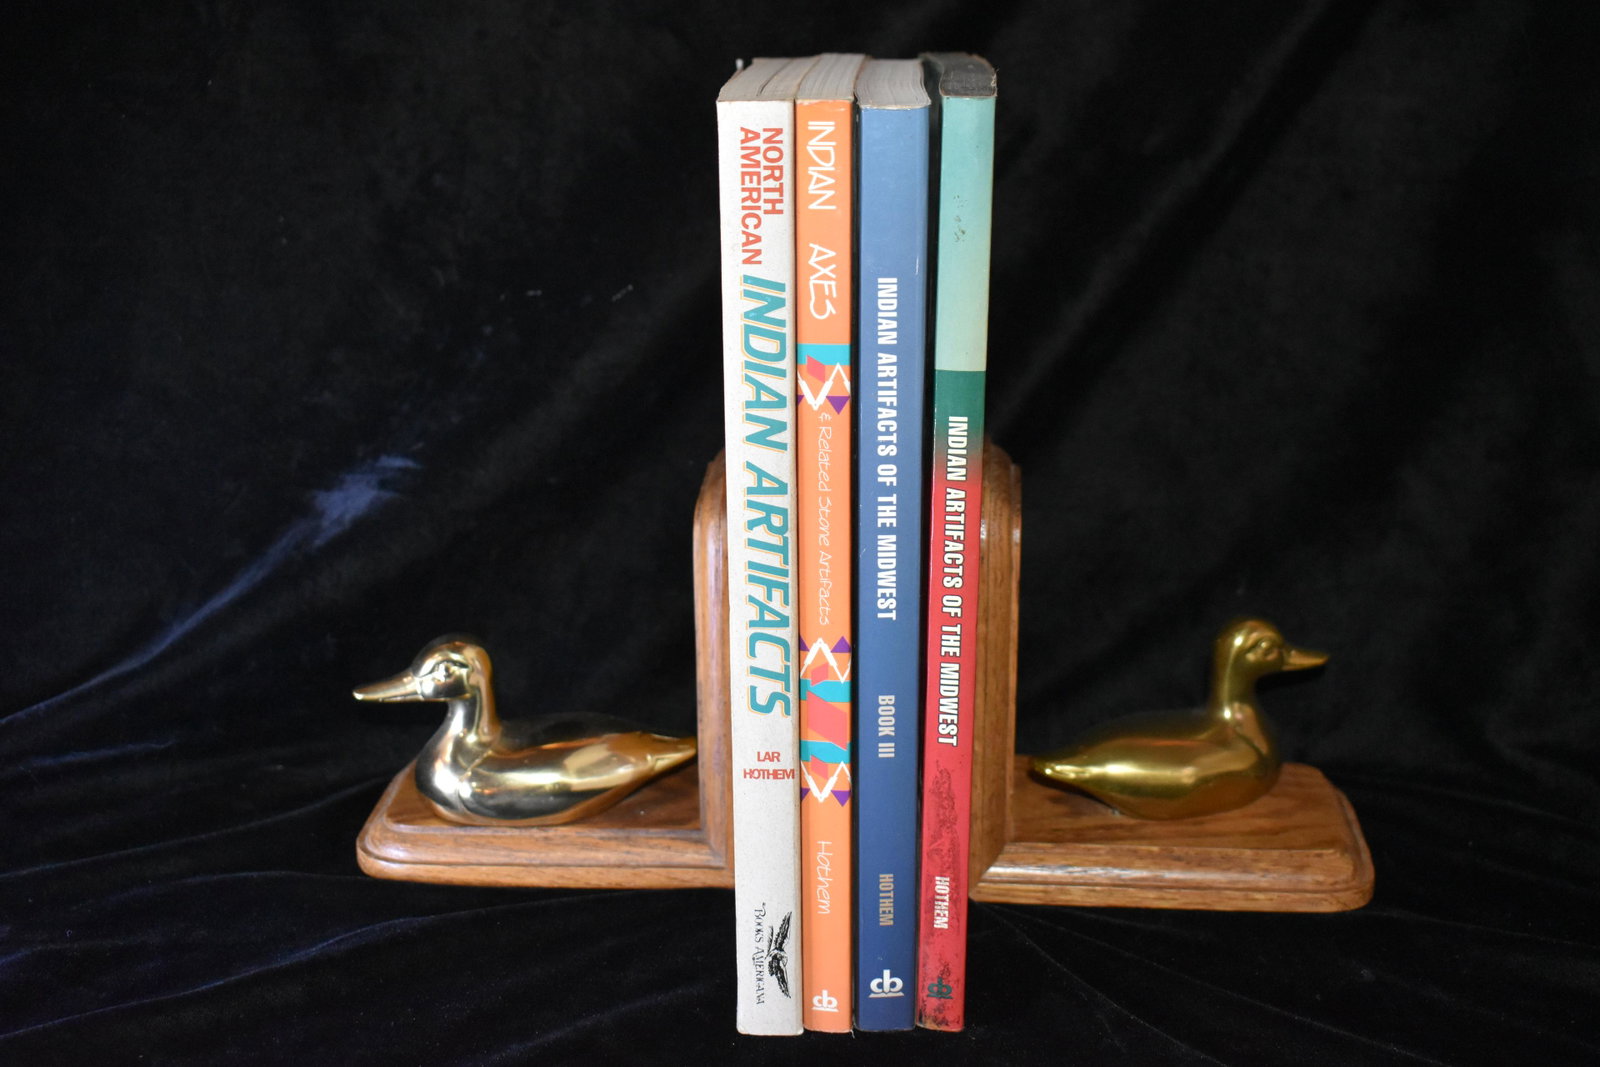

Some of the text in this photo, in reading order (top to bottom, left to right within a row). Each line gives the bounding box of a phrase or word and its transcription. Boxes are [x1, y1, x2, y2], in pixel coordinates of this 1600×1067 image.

[740, 126, 762, 265] AMERICAN
[762, 127, 784, 215] NORTH
[806, 121, 837, 320] INDIAN AXES
[818, 426, 832, 492] Related
[877, 277, 898, 621] INDIAN ARTIFACTS OF THE MIDWEST
[740, 274, 791, 718] INDIAN ARTIFACTS
[818, 496, 832, 547] Stone
[819, 550, 833, 627] Artifacts
[937, 415, 969, 747] INDIAN ARTIFACTS OF THE MIDWEST
[757, 751, 781, 763] LAR
[878, 695, 895, 758] BOOK III
[743, 768, 795, 780] HOTHEM
[816, 840, 833, 915] Hothem
[879, 873, 894, 927] HOTHEM
[933, 875, 950, 930] HOTHEM
